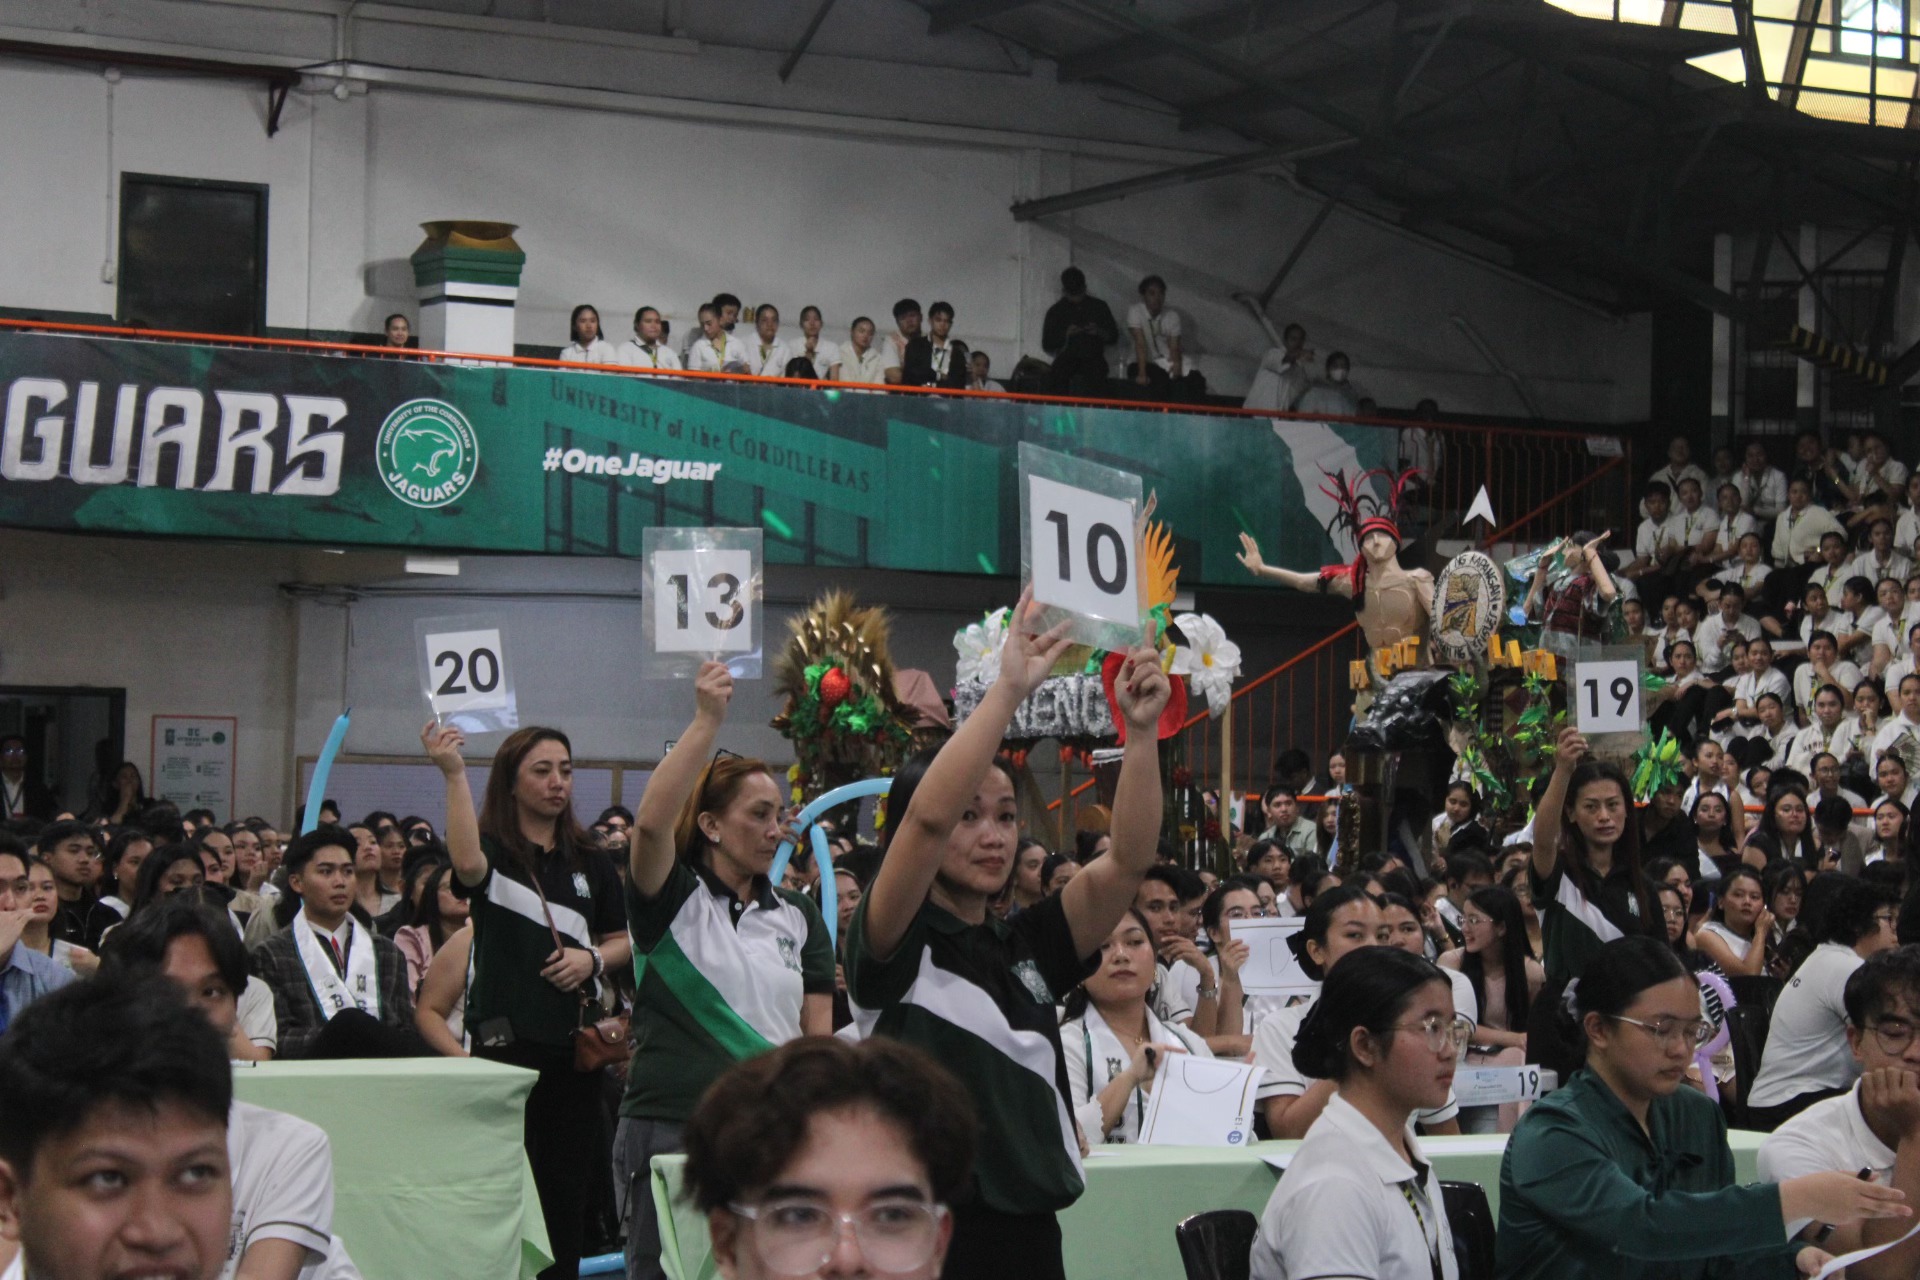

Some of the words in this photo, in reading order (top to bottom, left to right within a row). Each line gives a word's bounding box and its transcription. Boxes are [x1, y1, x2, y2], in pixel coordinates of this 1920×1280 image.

[1, 377, 348, 496] GUARS
[384, 408, 413, 444] UNIVERSITY
[413, 405, 423, 414] OF
[424, 405, 439, 414] THE
[439, 409, 471, 449] CORDILLERAS
[550, 375, 662, 431] UNIVERSITY
[666, 418, 685, 440] of
[691, 424, 722, 450] the
[729, 428, 871, 494] CORDILLERAS
[388, 472, 466, 502] JAGUARS
[542, 447, 722, 485] #OneJaguar
[1045, 509, 1128, 596] 10
[666, 572, 744, 630] 13
[434, 647, 499, 696] 20
[1583, 676, 1634, 718] 19
[1518, 1070, 1539, 1098] 19
